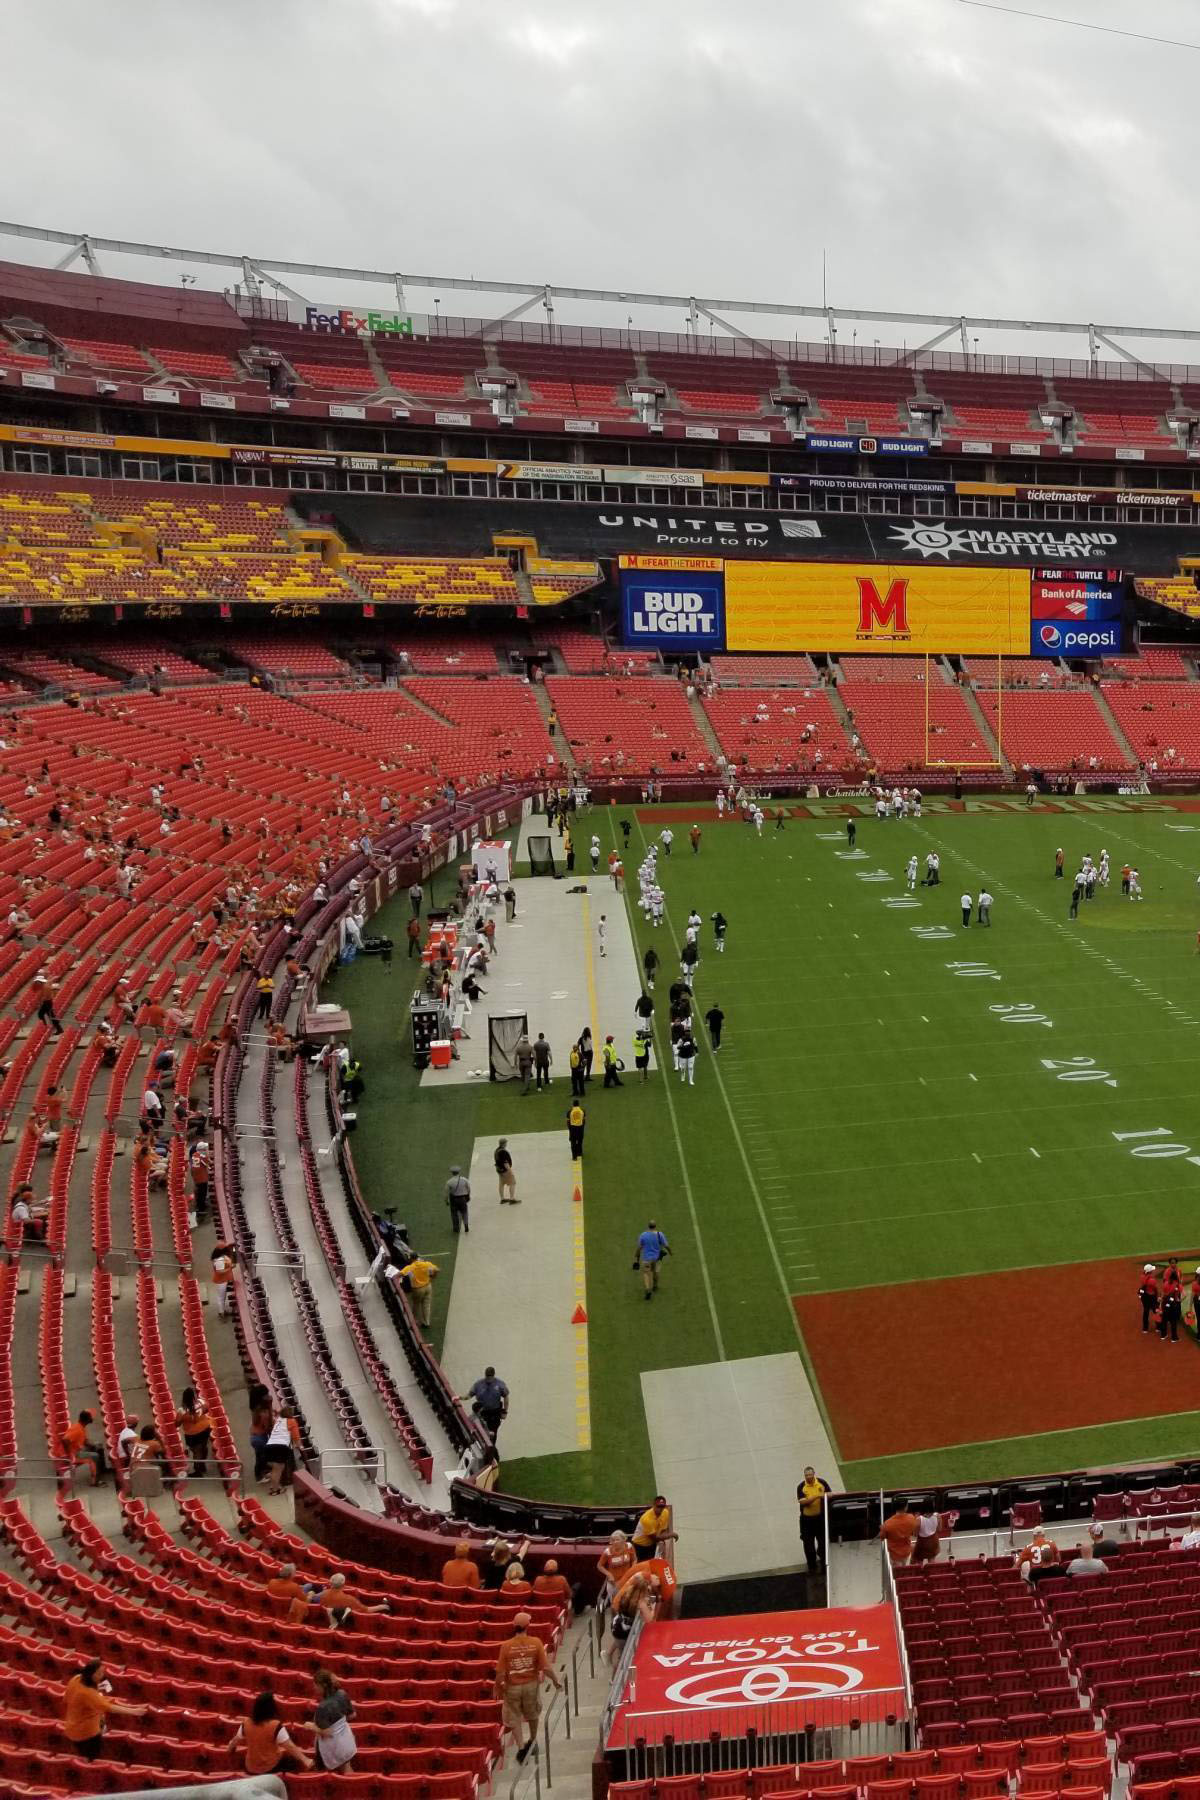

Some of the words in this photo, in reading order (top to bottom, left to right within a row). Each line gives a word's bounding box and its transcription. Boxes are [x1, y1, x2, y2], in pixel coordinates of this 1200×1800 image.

[305, 307, 413, 334] FedExField
[810, 439, 829, 447] BUD
[829, 440, 854, 449] LIGHT
[861, 440, 875, 450] 40
[882, 443, 900, 451] BUD
[900, 443, 925, 453] LIGHT
[809, 478, 836, 488] PROUD
[836, 480, 847, 488] TO
[847, 480, 878, 490] DELIVER
[878, 481, 893, 490] FOR
[894, 482, 909, 491] THE
[1027, 489, 1093, 502] ticketmaster
[1116, 492, 1181, 506] ticketmaster
[598, 515, 769, 534] UNITED
[656, 534, 713, 544] Proud
[720, 537, 739, 546] to
[746, 537, 769, 548] fly
[967, 529, 1118, 546] MARYLAND
[972, 541, 1094, 558] LOTTERY
[642, 558, 716, 569] #FEARTHETURTLE
[1041, 588, 1065, 600] Bank
[1065, 588, 1075, 600] of
[1075, 588, 1113, 600] America
[644, 592, 703, 613] BUD
[855, 577, 911, 633] M
[633, 612, 715, 633] LIGHT
[1065, 631, 1115, 649] pepsi
[825, 786, 871, 799] Charitable
[908, 925, 957, 940] 50
[945, 961, 998, 977] 40
[988, 1003, 1048, 1023] 30
[1039, 1056, 1111, 1081] 20
[1111, 1126, 1192, 1159] 10
[760, 1635, 795, 1644] Go
[801, 1630, 857, 1641] Let's
[672, 1638, 755, 1651] Places
[652, 1638, 880, 1668] TOYOTA
